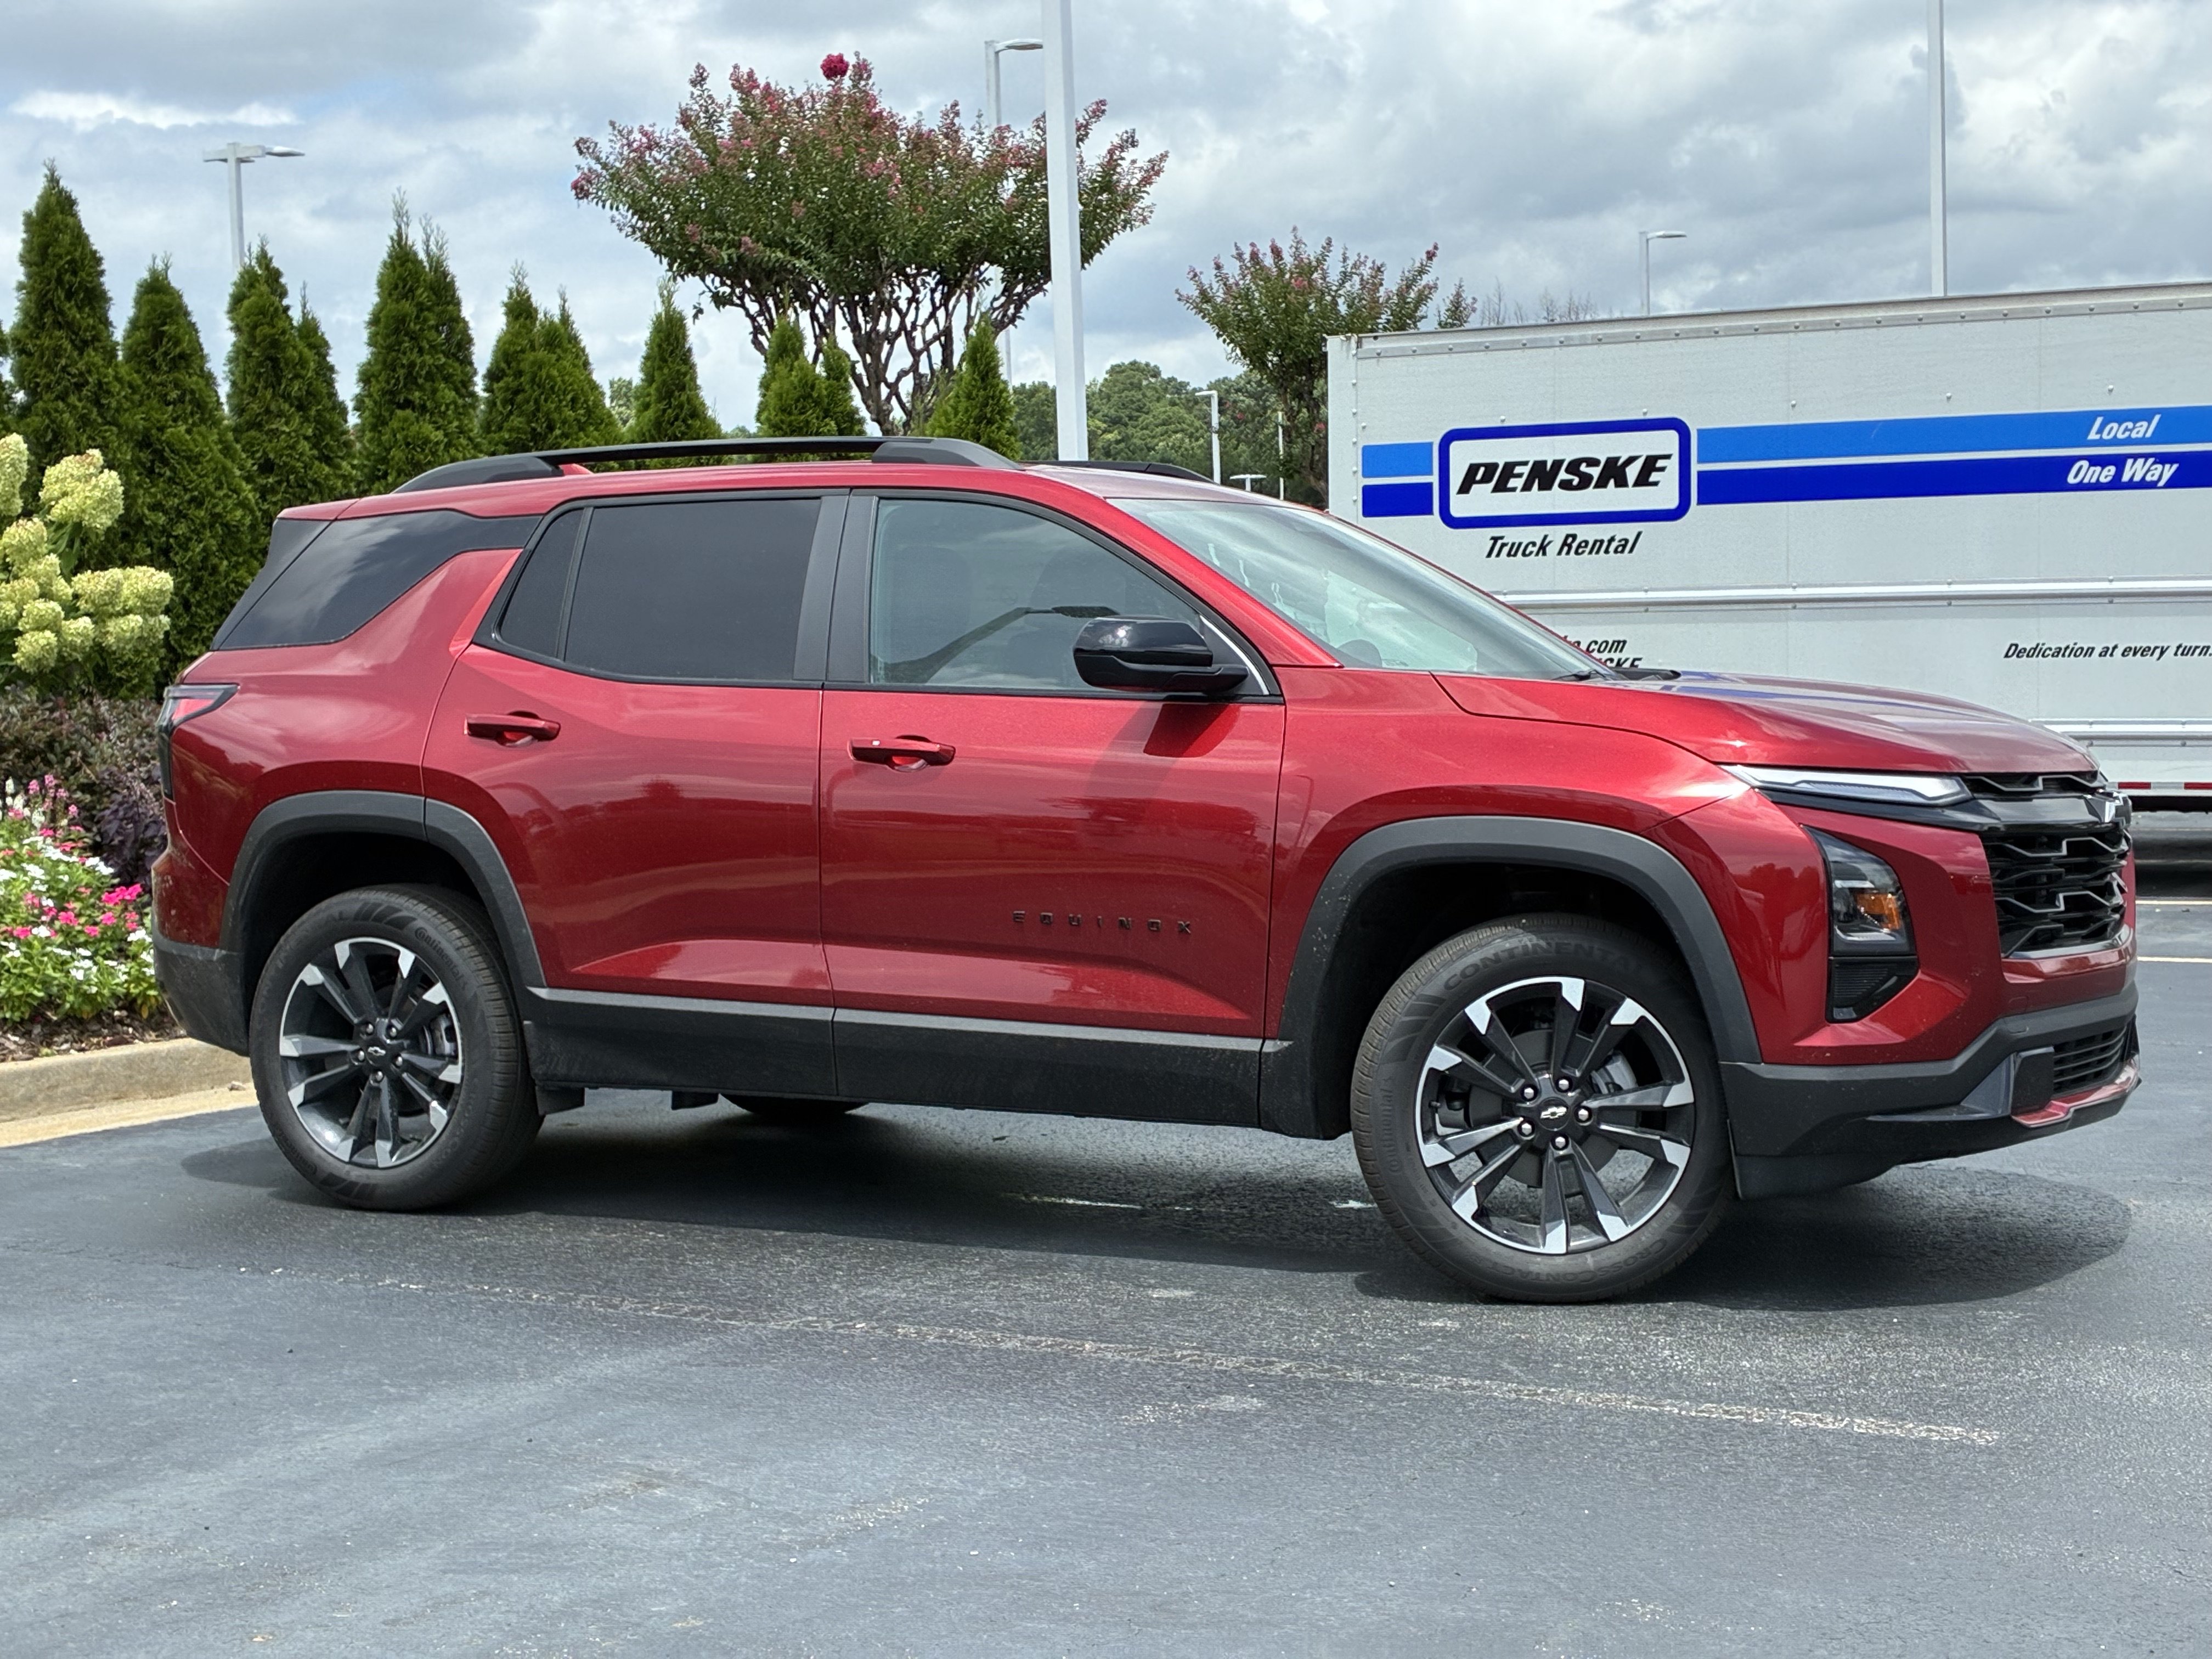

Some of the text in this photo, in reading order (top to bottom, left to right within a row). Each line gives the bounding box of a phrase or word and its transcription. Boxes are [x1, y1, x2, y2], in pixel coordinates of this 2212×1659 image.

[2087, 414, 2161, 439] Local
[1456, 454, 1673, 495] PENSKE
[2067, 458, 2179, 487] One Way
[1485, 531, 1643, 558] Truck Rental
[2004, 642, 2096, 659] Dedication
[2098, 644, 2118, 658] at
[2121, 645, 2170, 661] every
[1013, 911, 1191, 934] EQUINOX
[415, 926, 464, 982] Continental
[1443, 941, 1640, 991] CONTINENTAL
